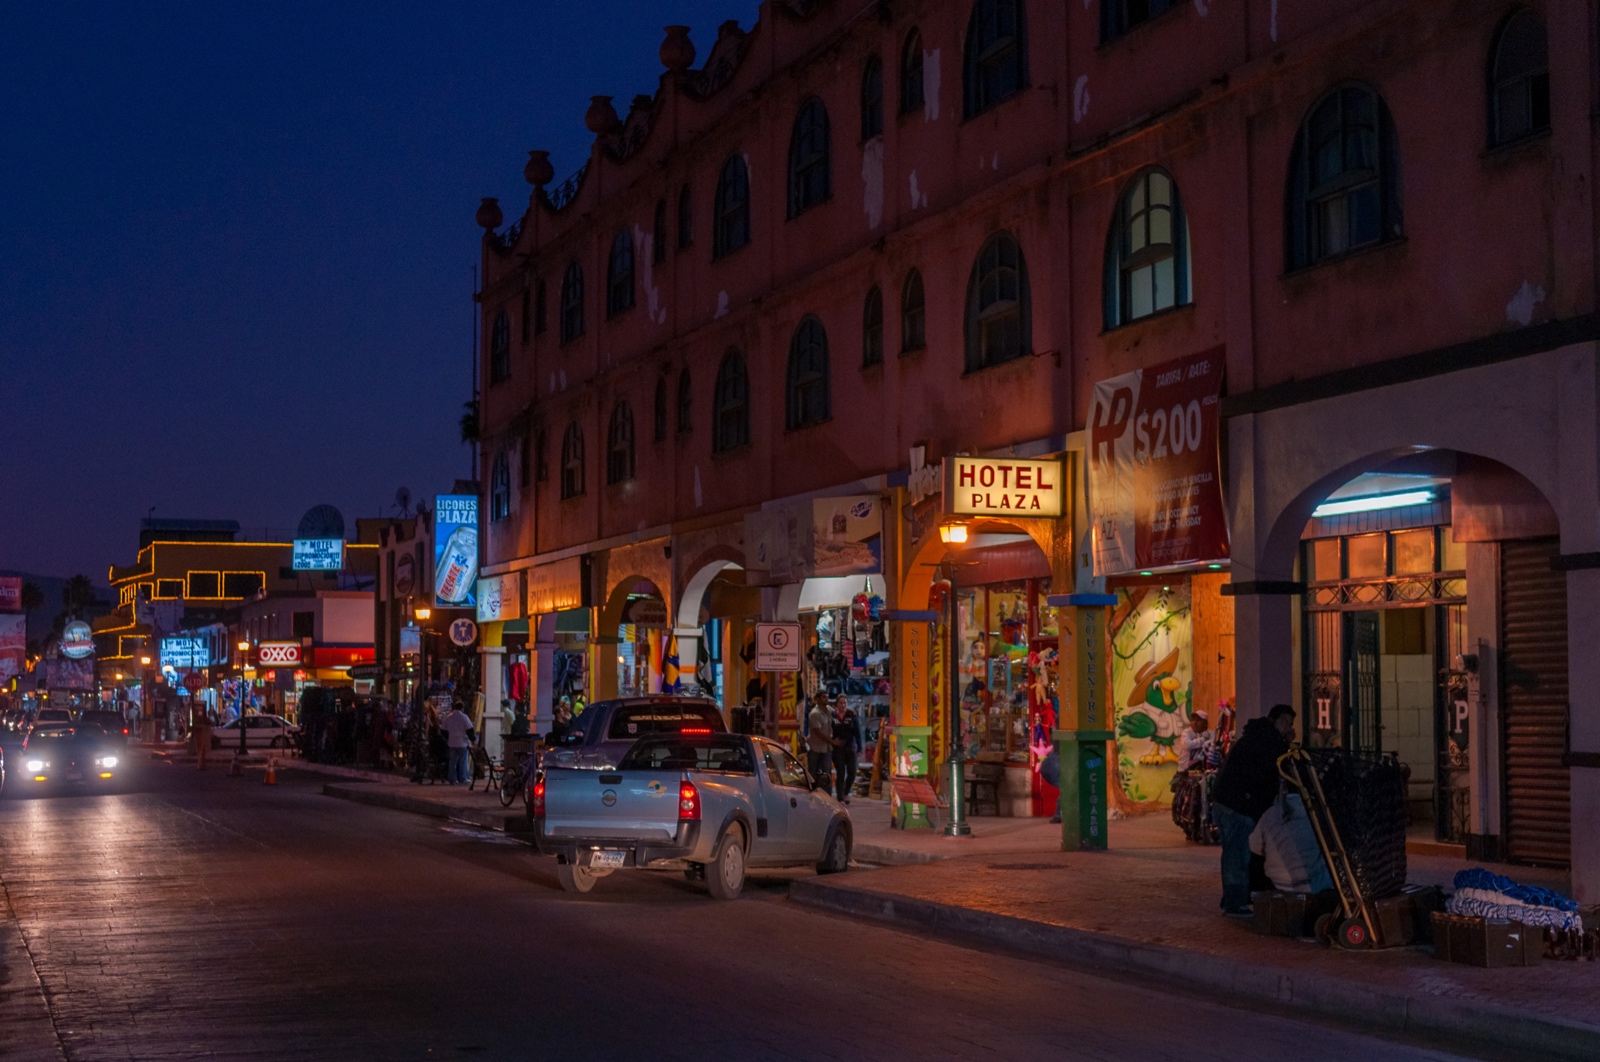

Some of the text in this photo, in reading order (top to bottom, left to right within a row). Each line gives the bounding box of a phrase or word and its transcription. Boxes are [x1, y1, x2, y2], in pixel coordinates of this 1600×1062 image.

[1155, 368, 1181, 388] TARIFA
[1135, 400, 1202, 466] $200
[960, 464, 1053, 490] HOTEL
[436, 500, 477, 510] LICORES
[972, 493, 1041, 510] PLAZA
[436, 510, 477, 524] PLAZA
[440, 563, 461, 597] TECATE
[260, 648, 298, 661] OXXO
[1085, 610, 1096, 724] SOUVENIRS
[186, 678, 202, 686] ALTO
[910, 626, 920, 722] SOUVENIRS
[1316, 698, 1332, 729] H
[1454, 700, 1468, 734] P
[1089, 772, 1099, 837] CIGARS
